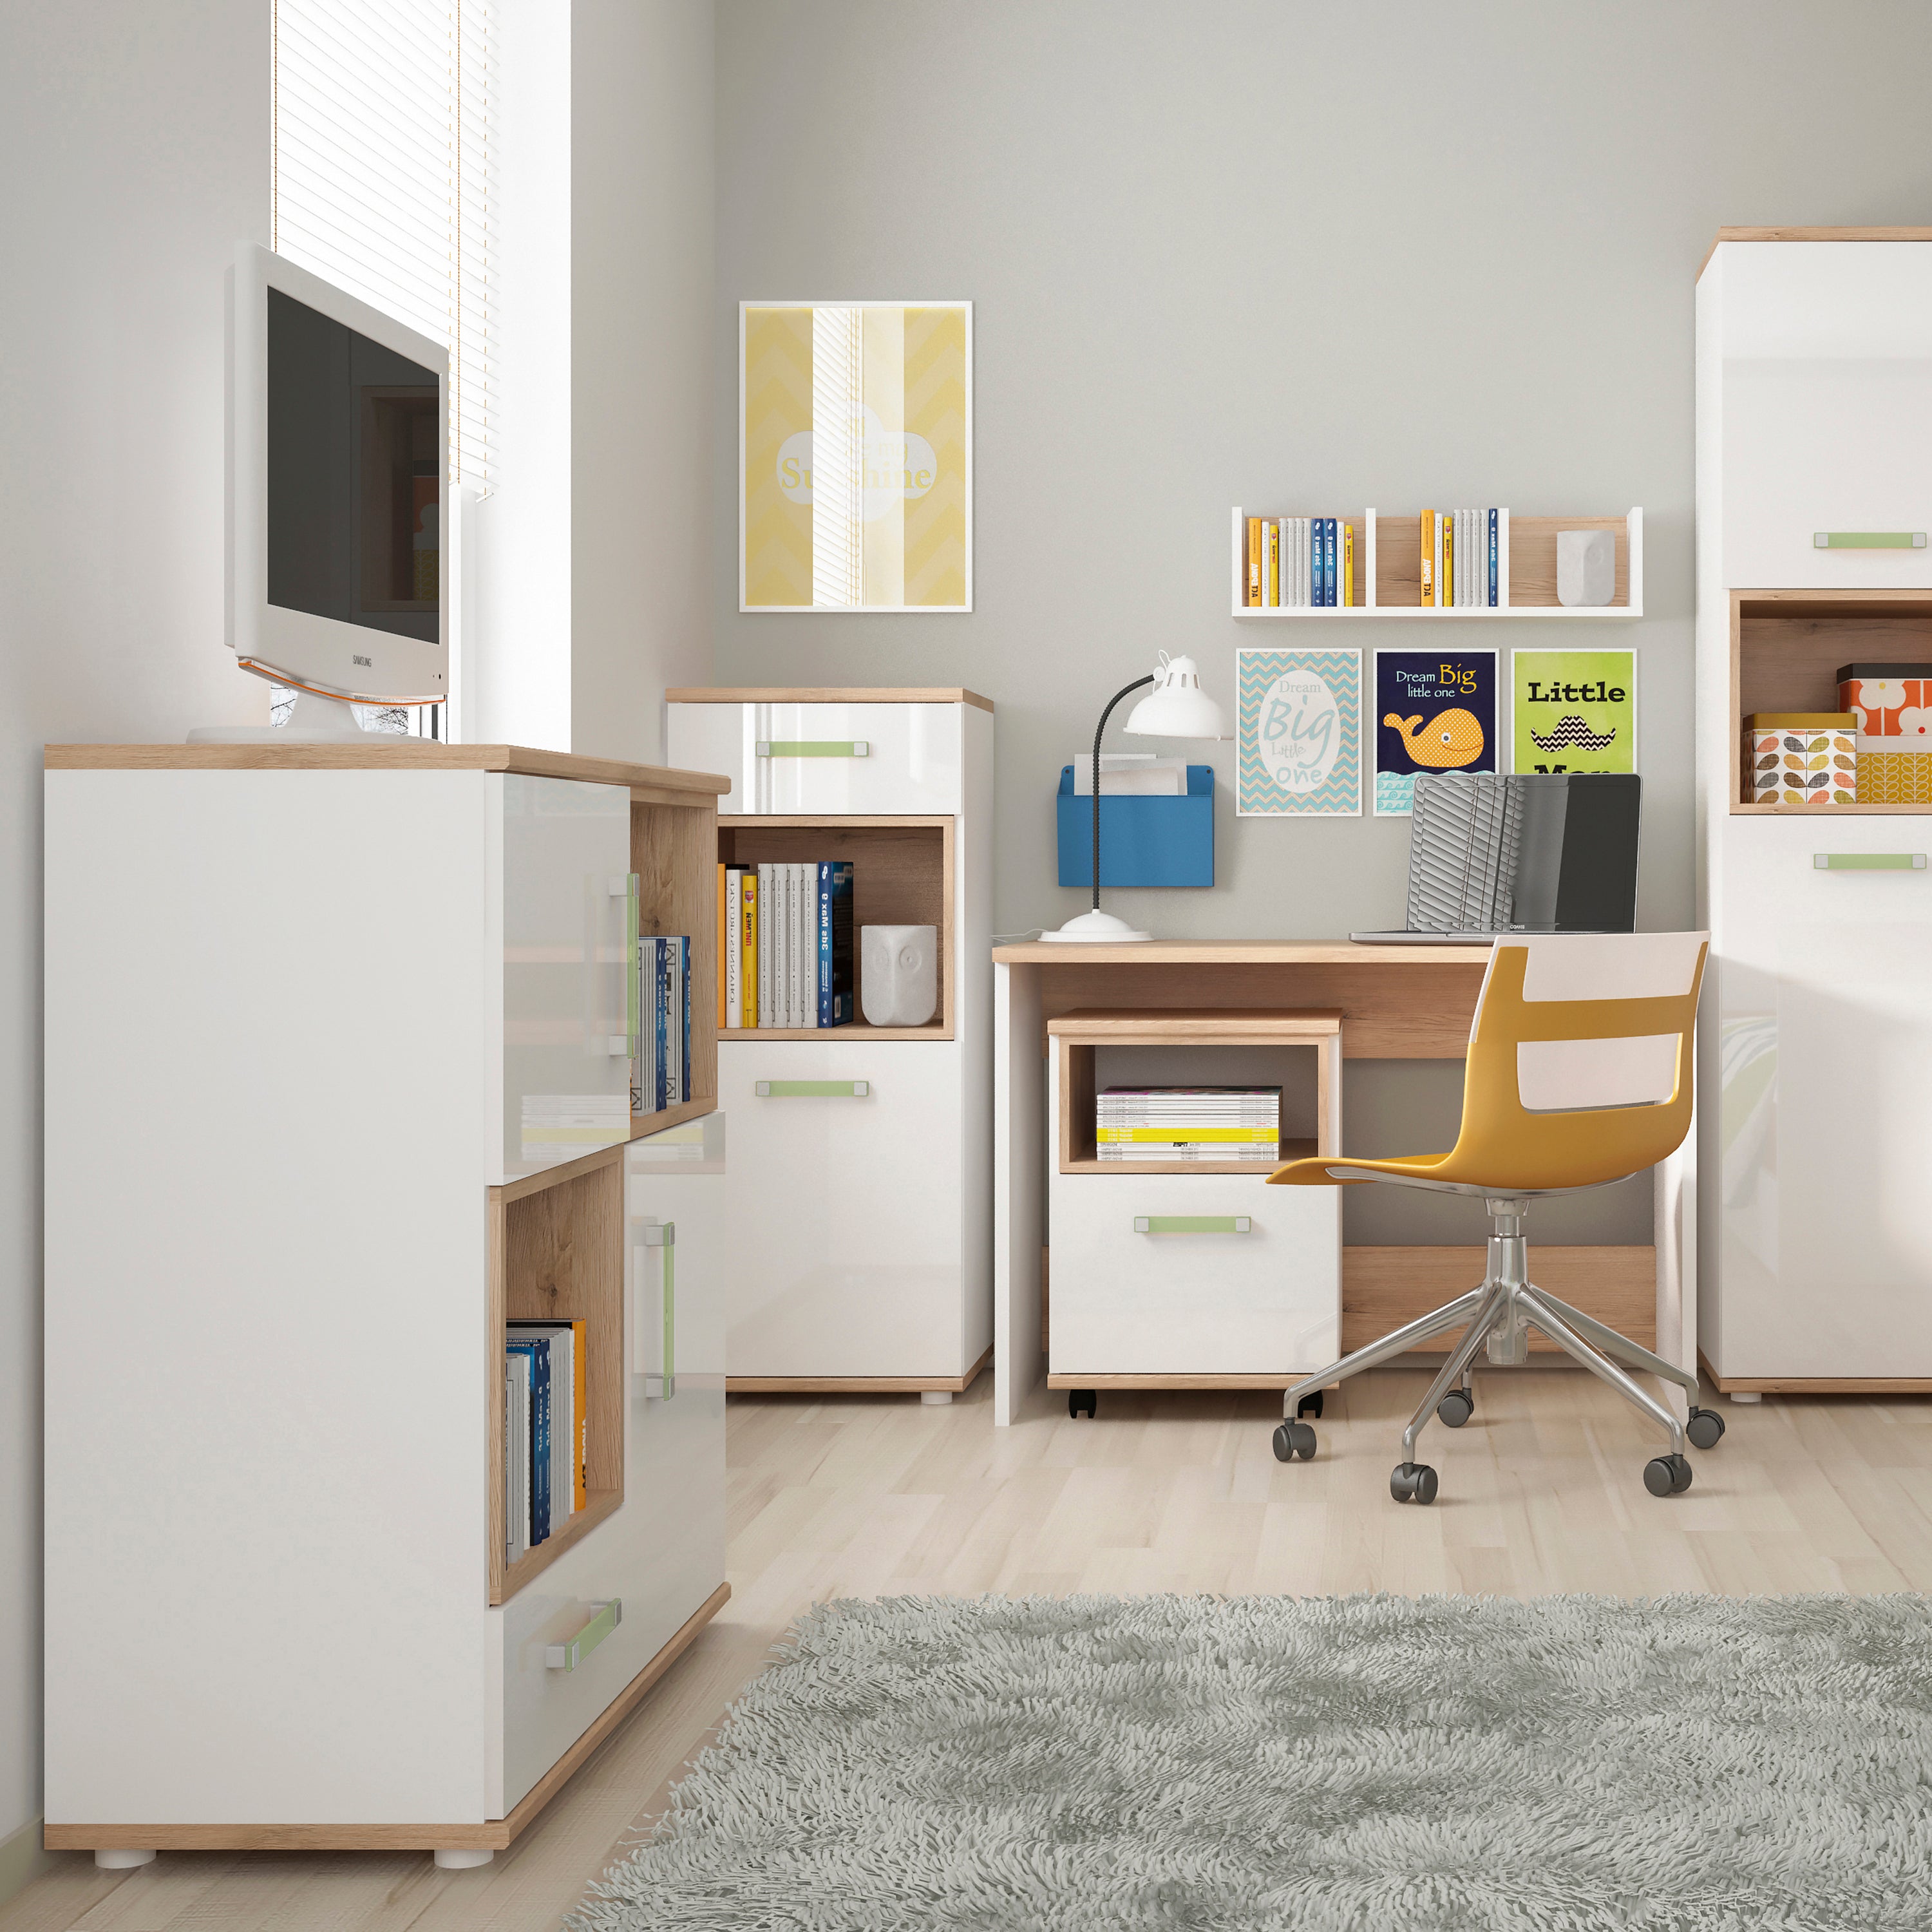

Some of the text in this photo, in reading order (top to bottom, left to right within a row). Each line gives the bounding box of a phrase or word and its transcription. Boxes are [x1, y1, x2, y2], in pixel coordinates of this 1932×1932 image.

[781, 457, 931, 489] Shine
[352, 654, 372, 667] SAMSUNG
[1279, 680, 1321, 693] Dream
[1396, 663, 1477, 694] Dream Big
[1408, 685, 1455, 697] little one
[1528, 681, 1625, 703] Little
[1263, 695, 1336, 769] Big
[1271, 741, 1307, 758] Little
